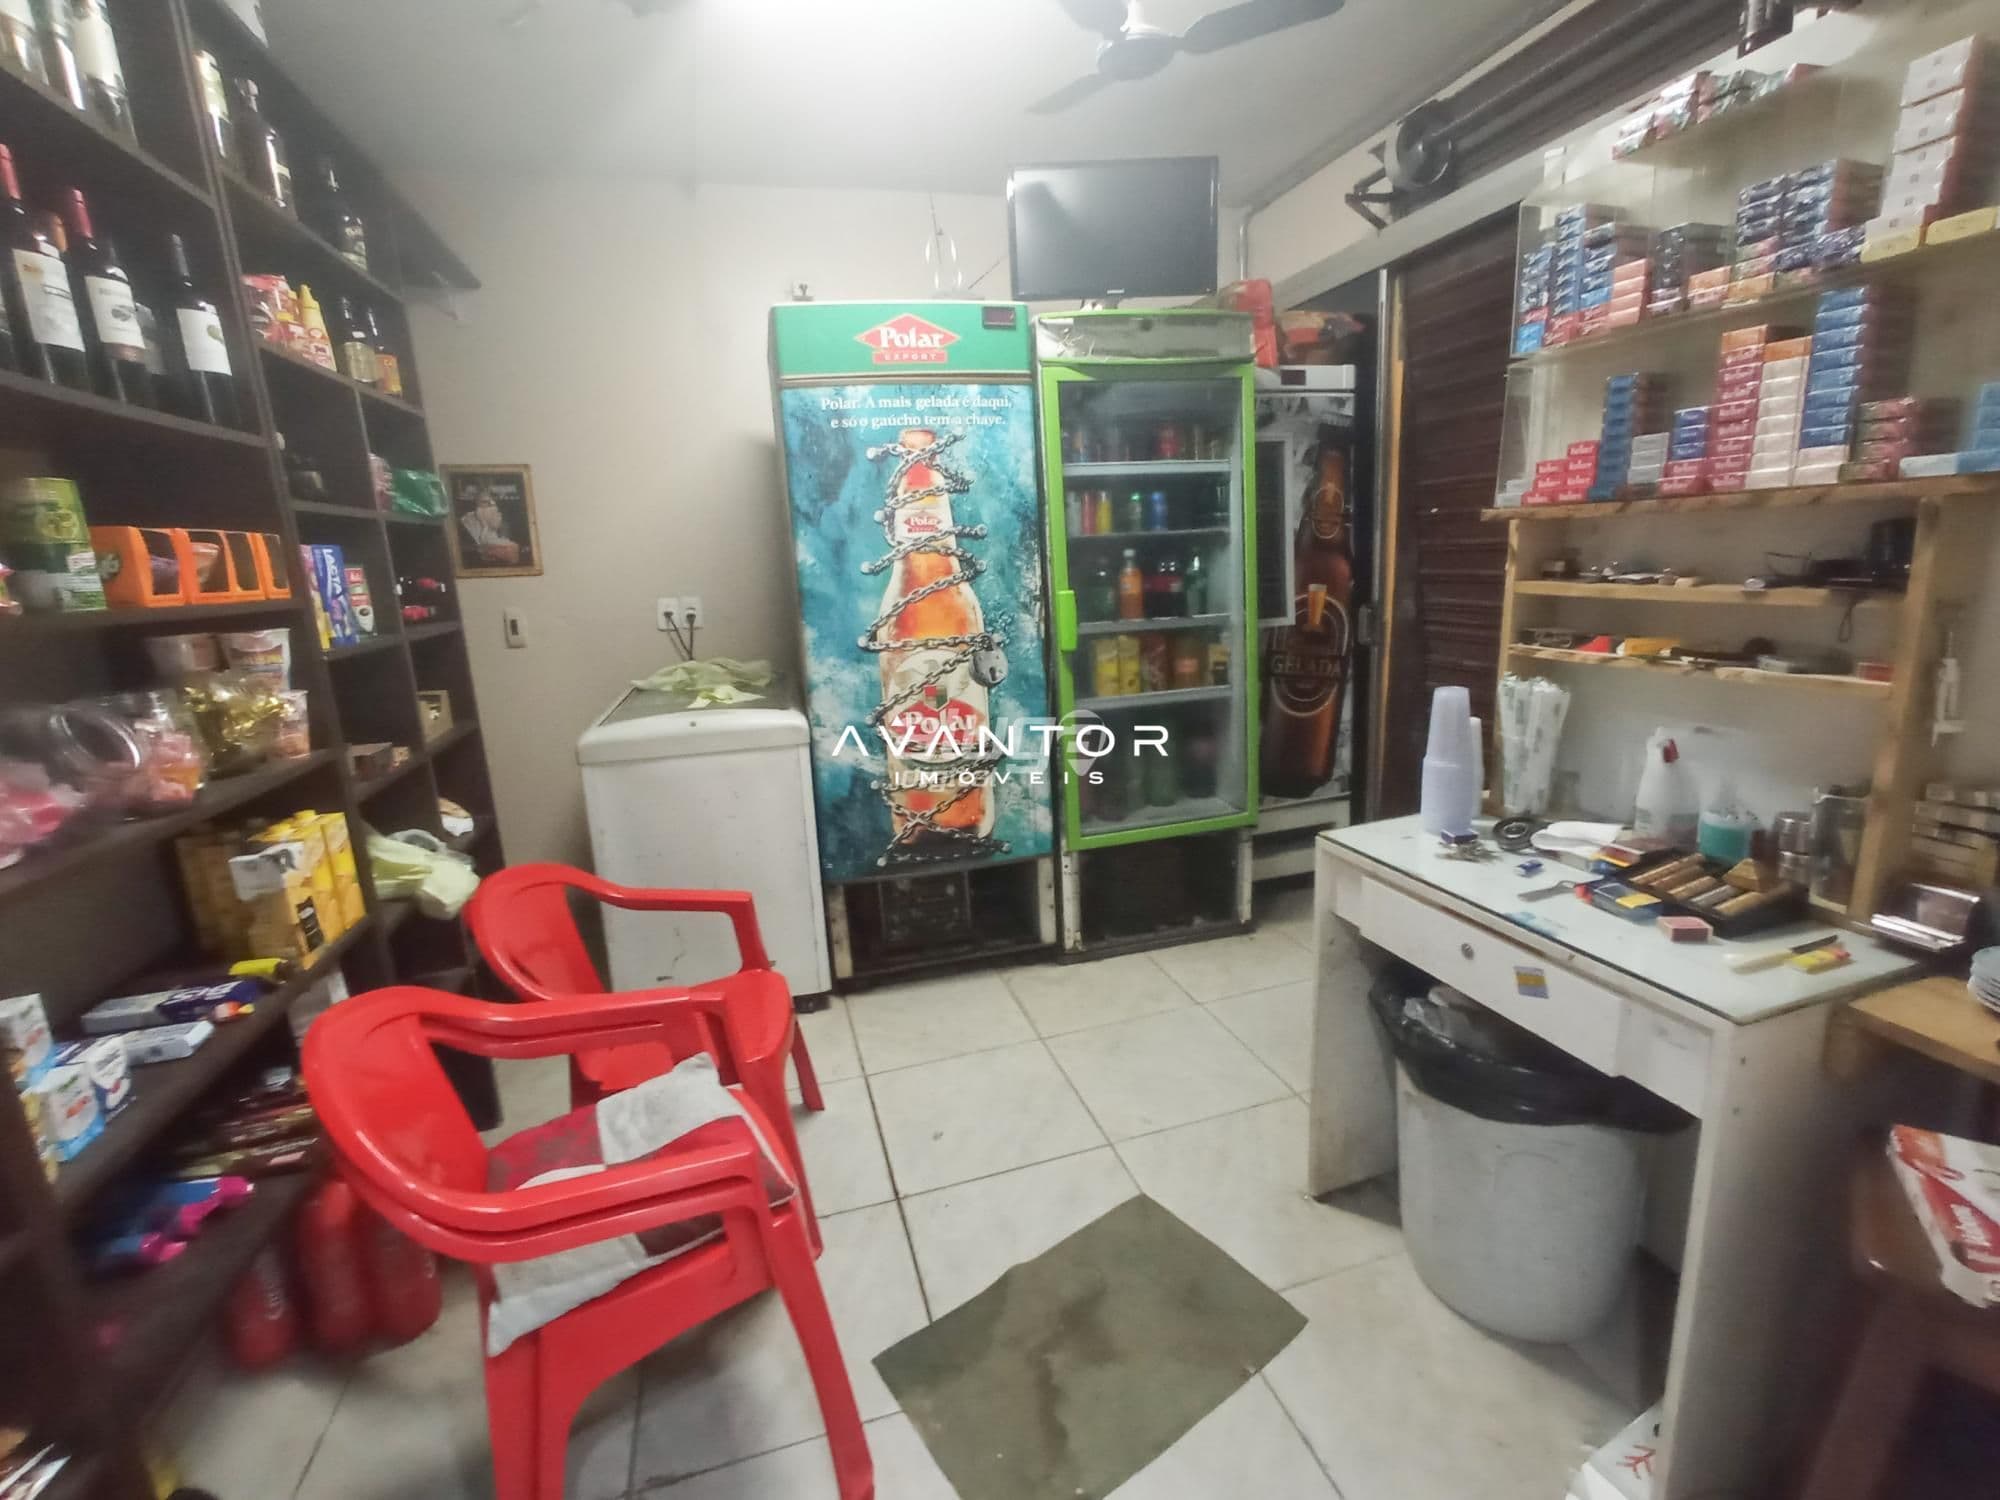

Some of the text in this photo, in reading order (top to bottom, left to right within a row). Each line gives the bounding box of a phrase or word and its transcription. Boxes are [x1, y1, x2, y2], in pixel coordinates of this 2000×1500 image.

[880, 327, 944, 348] Polar
[884, 353, 937, 361] EXPORT
[865, 397, 876, 408] A
[879, 396, 912, 408] mais
[916, 395, 959, 411] gelada
[831, 418, 839, 428] e
[860, 418, 868, 427] o
[871, 413, 921, 430] gaúcho
[925, 415, 948, 425] tem
